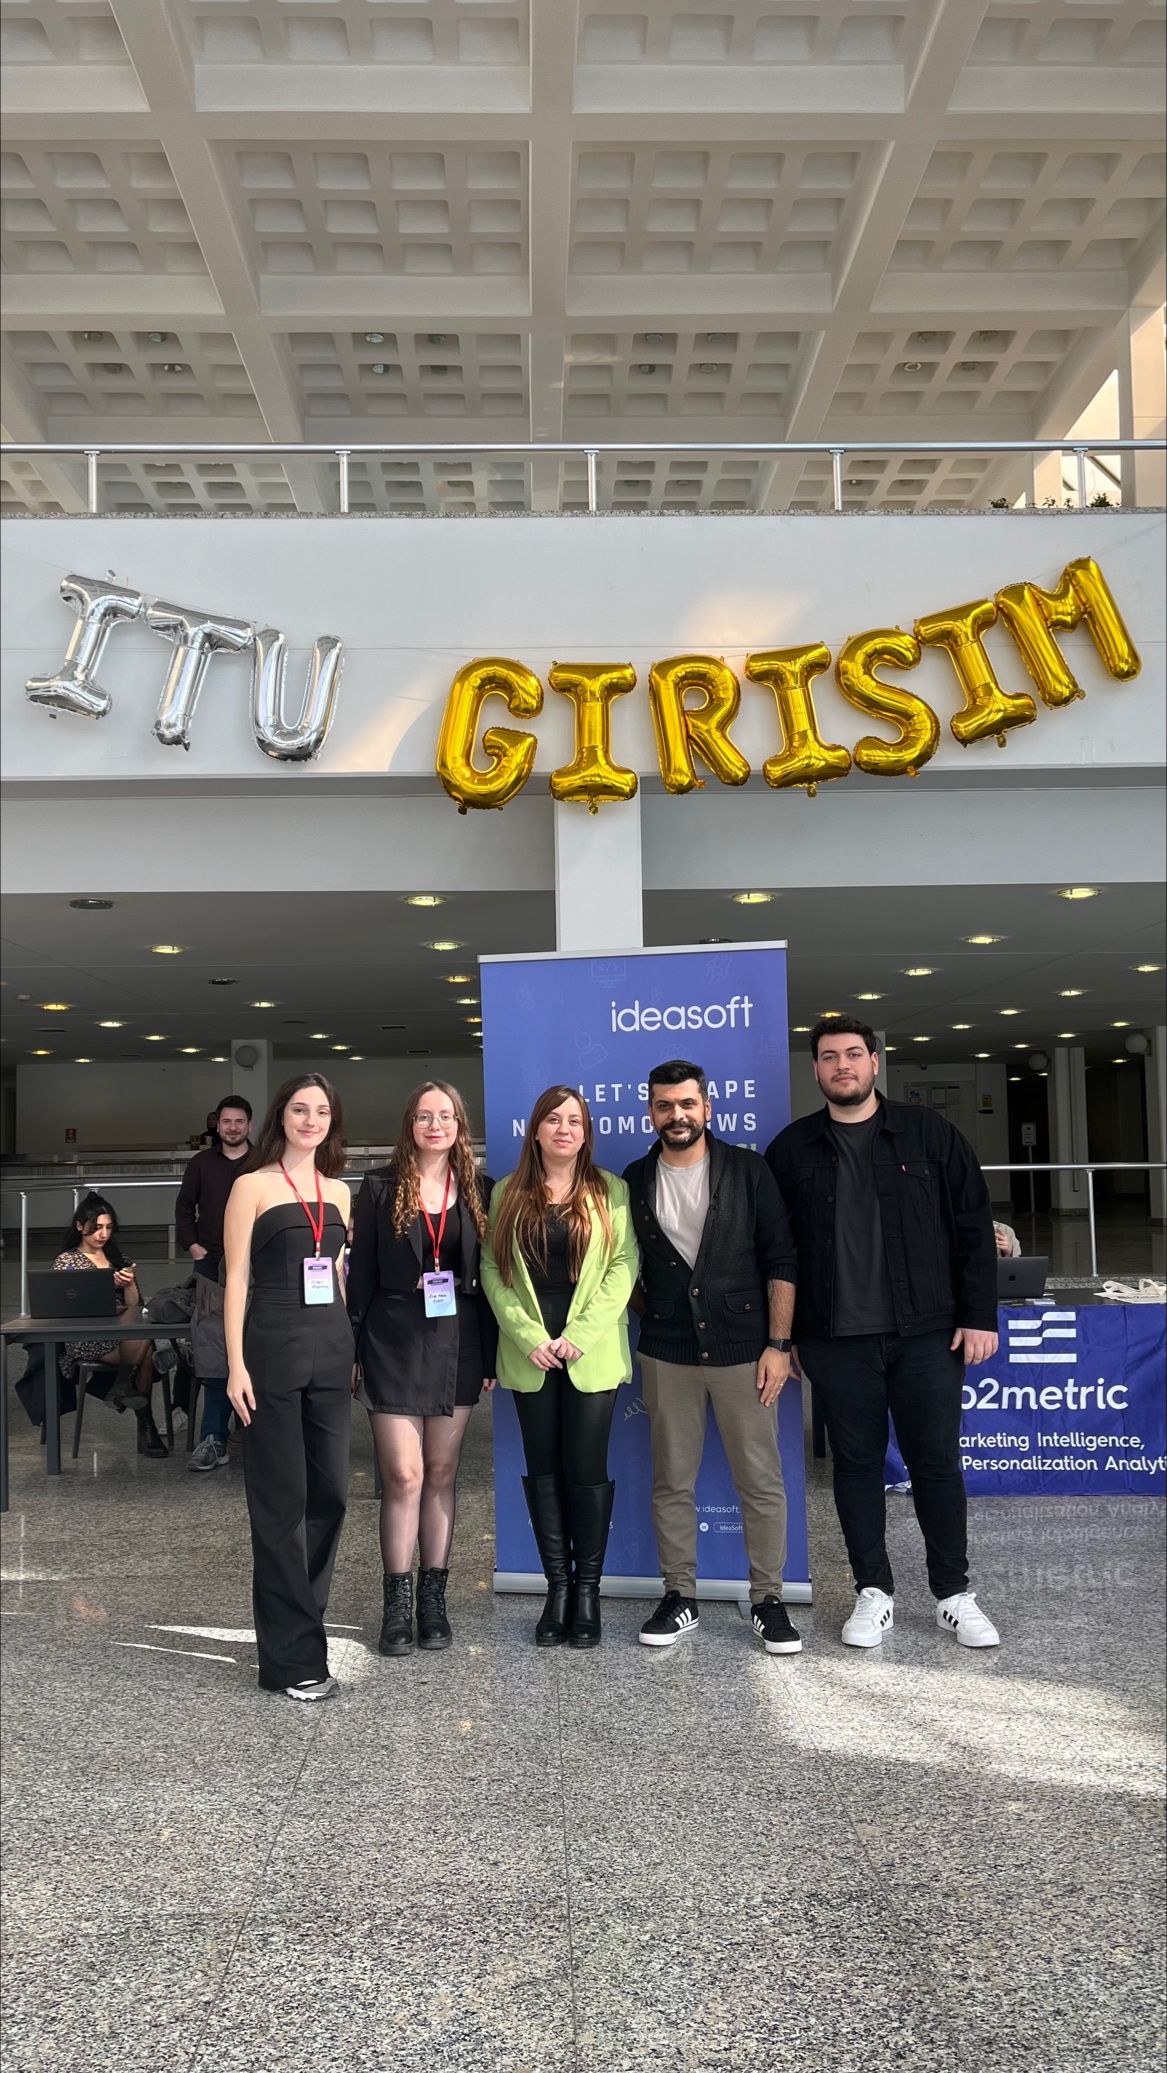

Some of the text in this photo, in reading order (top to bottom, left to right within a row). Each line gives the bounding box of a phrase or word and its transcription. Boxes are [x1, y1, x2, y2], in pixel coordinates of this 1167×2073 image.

[24, 556, 1142, 813] ITU GIRISIM
[611, 995, 754, 1032] ideasoft
[579, 1080, 756, 1102] LET'S APE
[591, 1113, 757, 1136] OMOWS
[959, 1432, 1145, 1451] arketing Intelligence,
[962, 1455, 1167, 1475] Personalization Analyti
